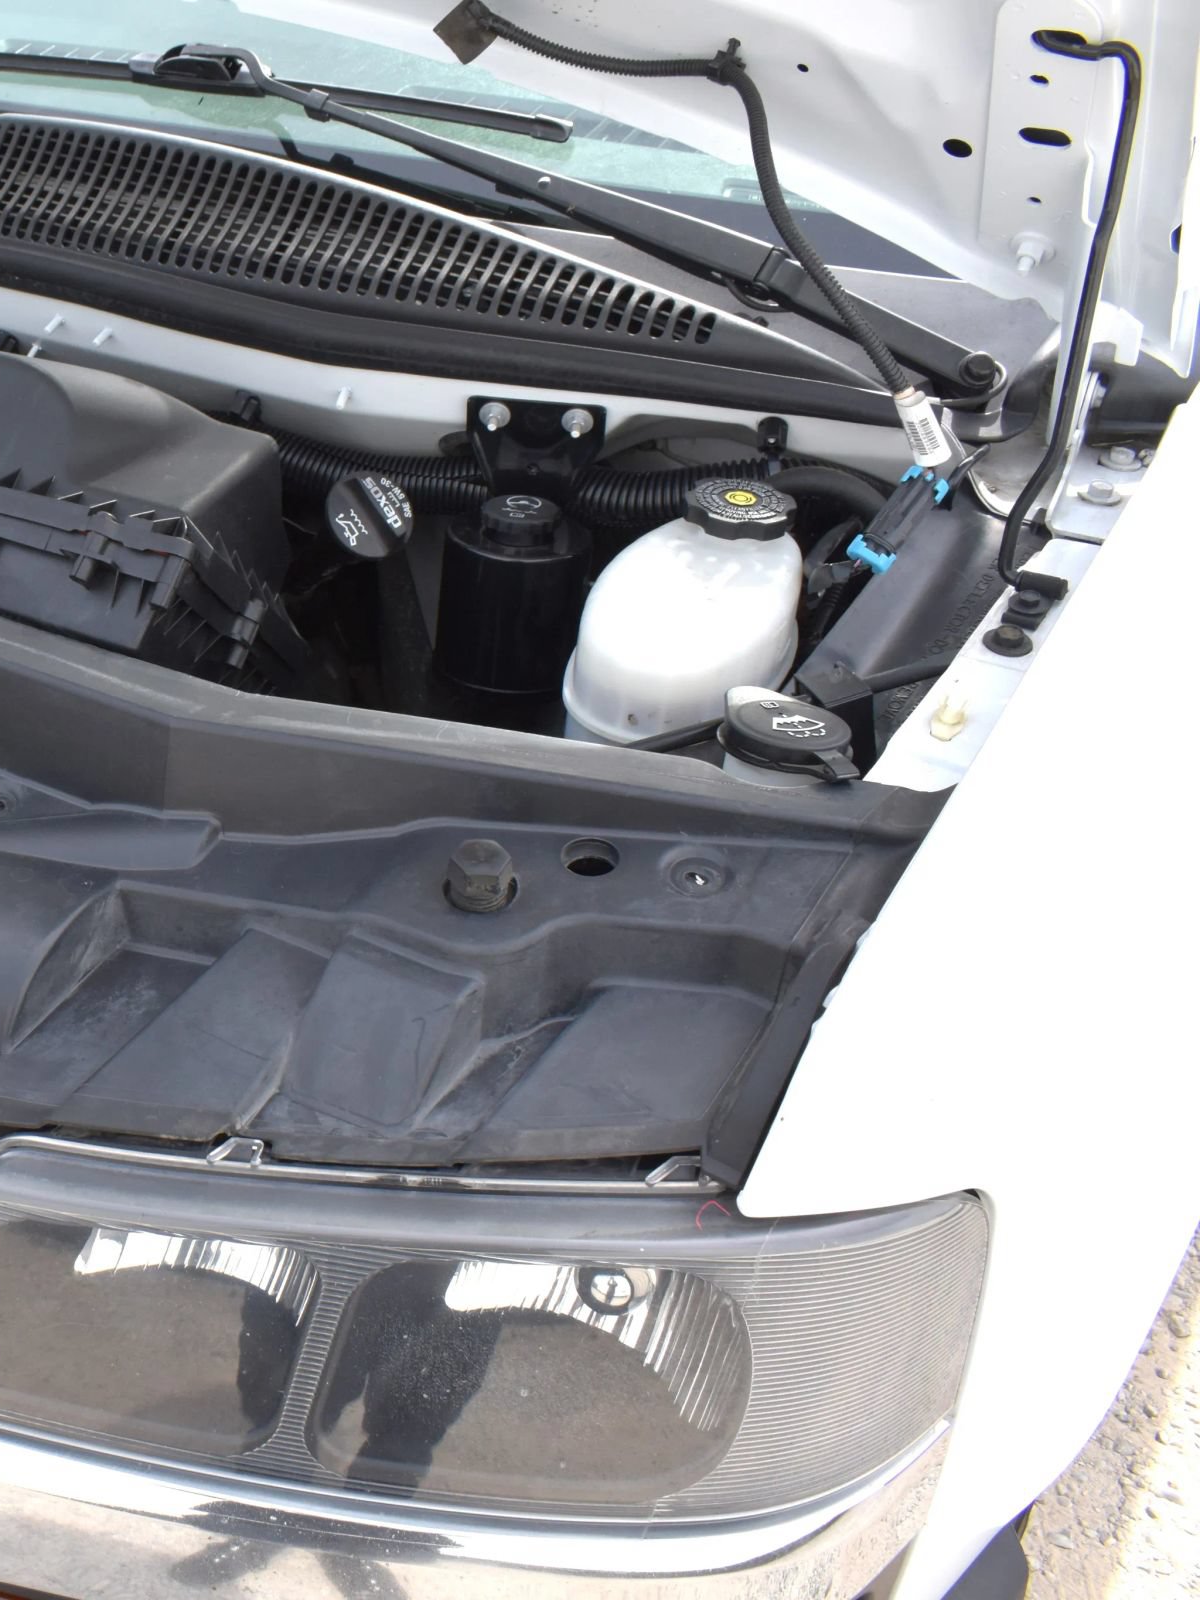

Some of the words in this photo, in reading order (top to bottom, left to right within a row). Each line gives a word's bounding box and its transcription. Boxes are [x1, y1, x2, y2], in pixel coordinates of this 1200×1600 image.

[380, 477, 406, 500] 5W-30
[361, 476, 403, 529] dexos
[401, 502, 413, 518] SAE
